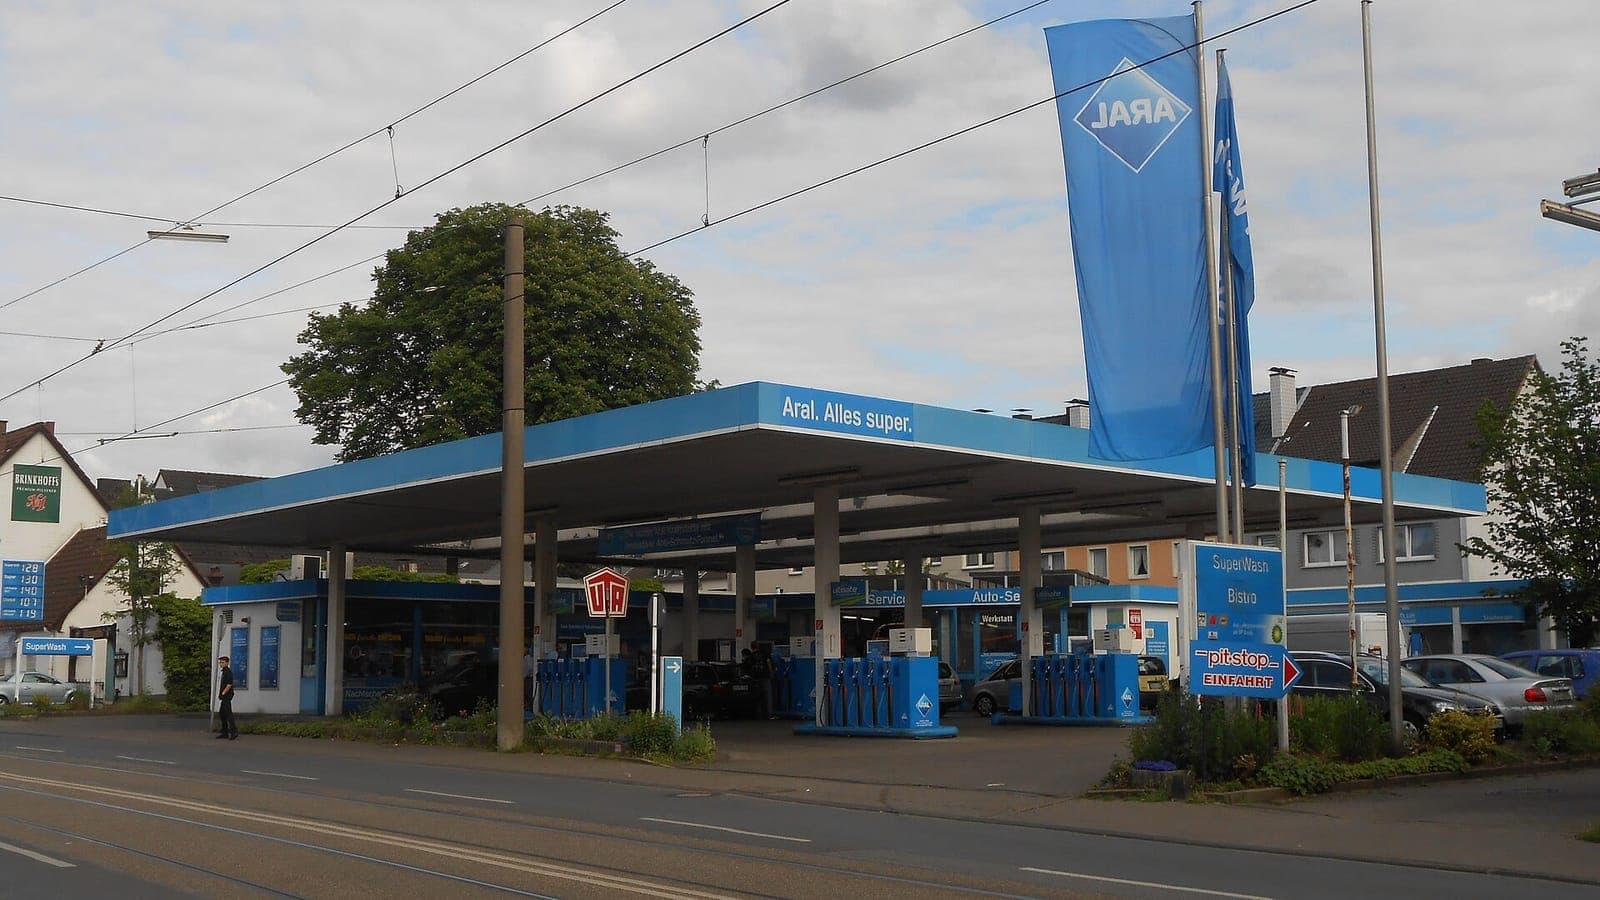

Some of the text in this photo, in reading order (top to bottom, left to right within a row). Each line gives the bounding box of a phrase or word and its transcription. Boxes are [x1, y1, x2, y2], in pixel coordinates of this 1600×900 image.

[782, 396, 912, 434] Aral. Alles super.
[22, 563, 39, 573] 128
[1213, 554, 1269, 574] SuperWash
[21, 575, 38, 584] 130
[20, 586, 38, 596] 140
[1228, 587, 1257, 605] Bistro
[982, 614, 1014, 623] Werkstatt
[25, 642, 67, 652] SuperWash
[1203, 672, 1274, 689] EINFAHRT
